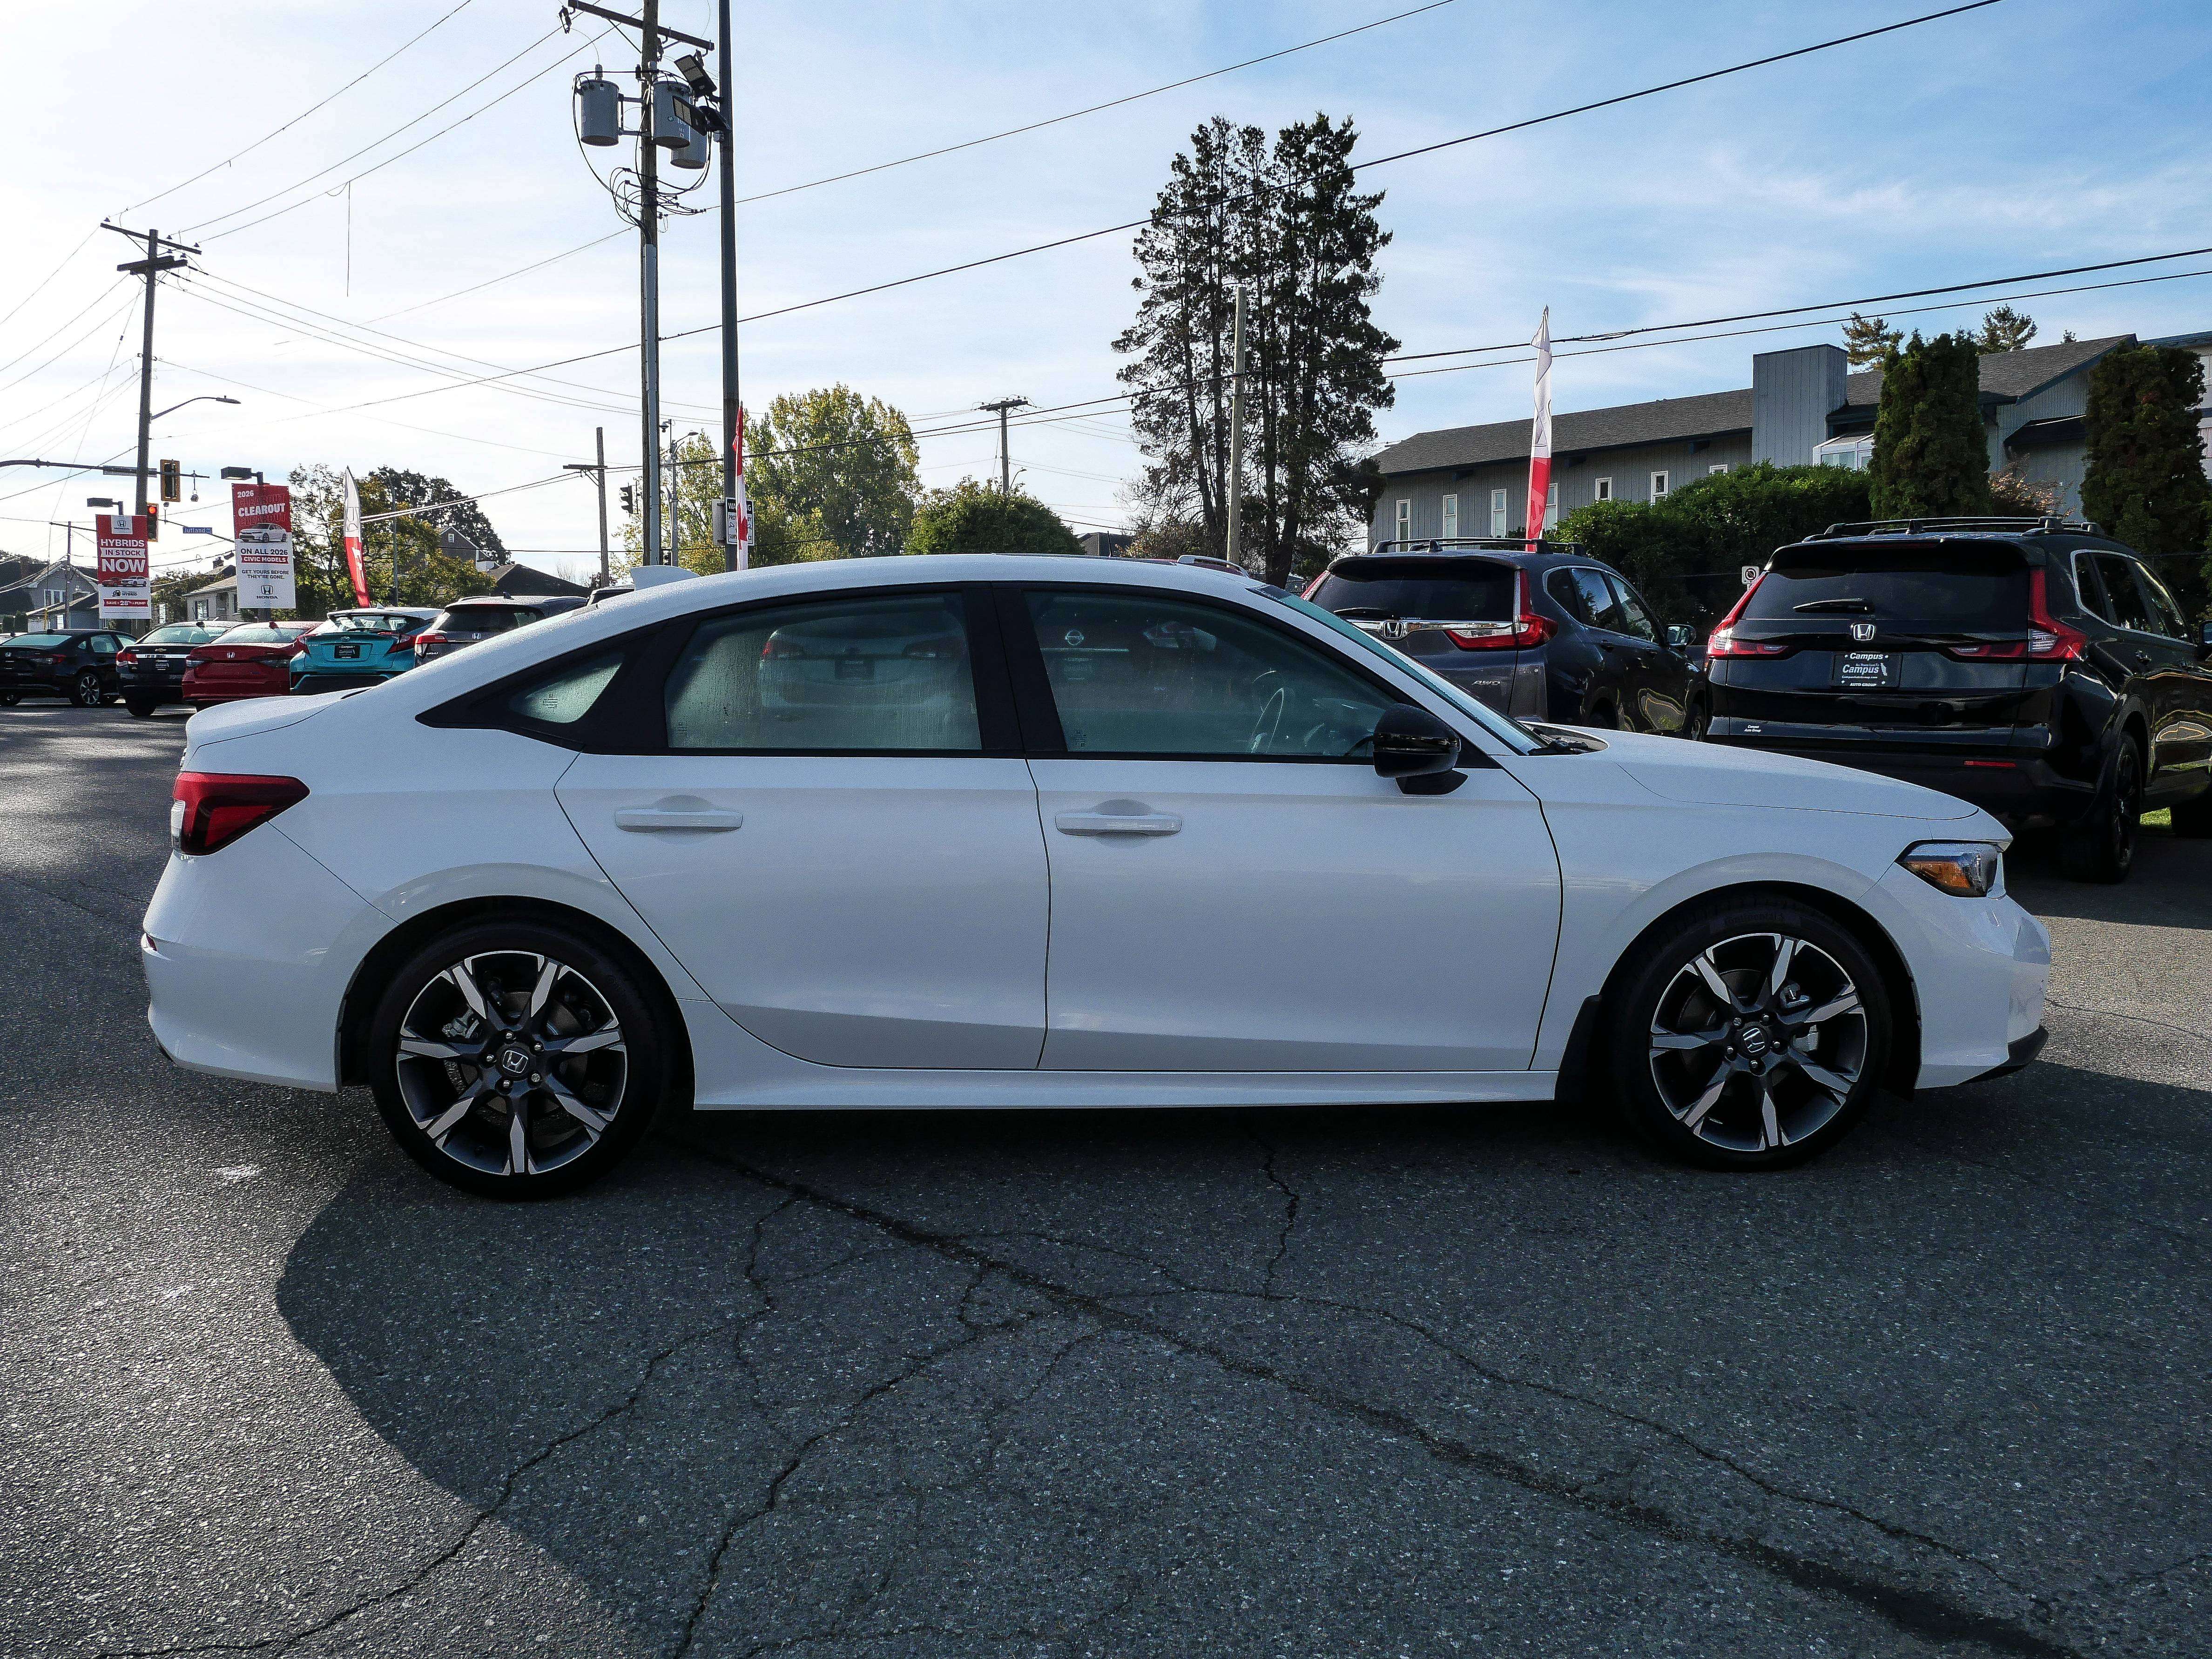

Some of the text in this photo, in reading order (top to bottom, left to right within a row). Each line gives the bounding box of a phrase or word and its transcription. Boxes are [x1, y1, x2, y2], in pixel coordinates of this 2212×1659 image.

[238, 503, 285, 517] CLEAROUT
[102, 559, 146, 572] NOW
[1850, 653, 1883, 661] Campus
[1842, 664, 1879, 675] Campus
